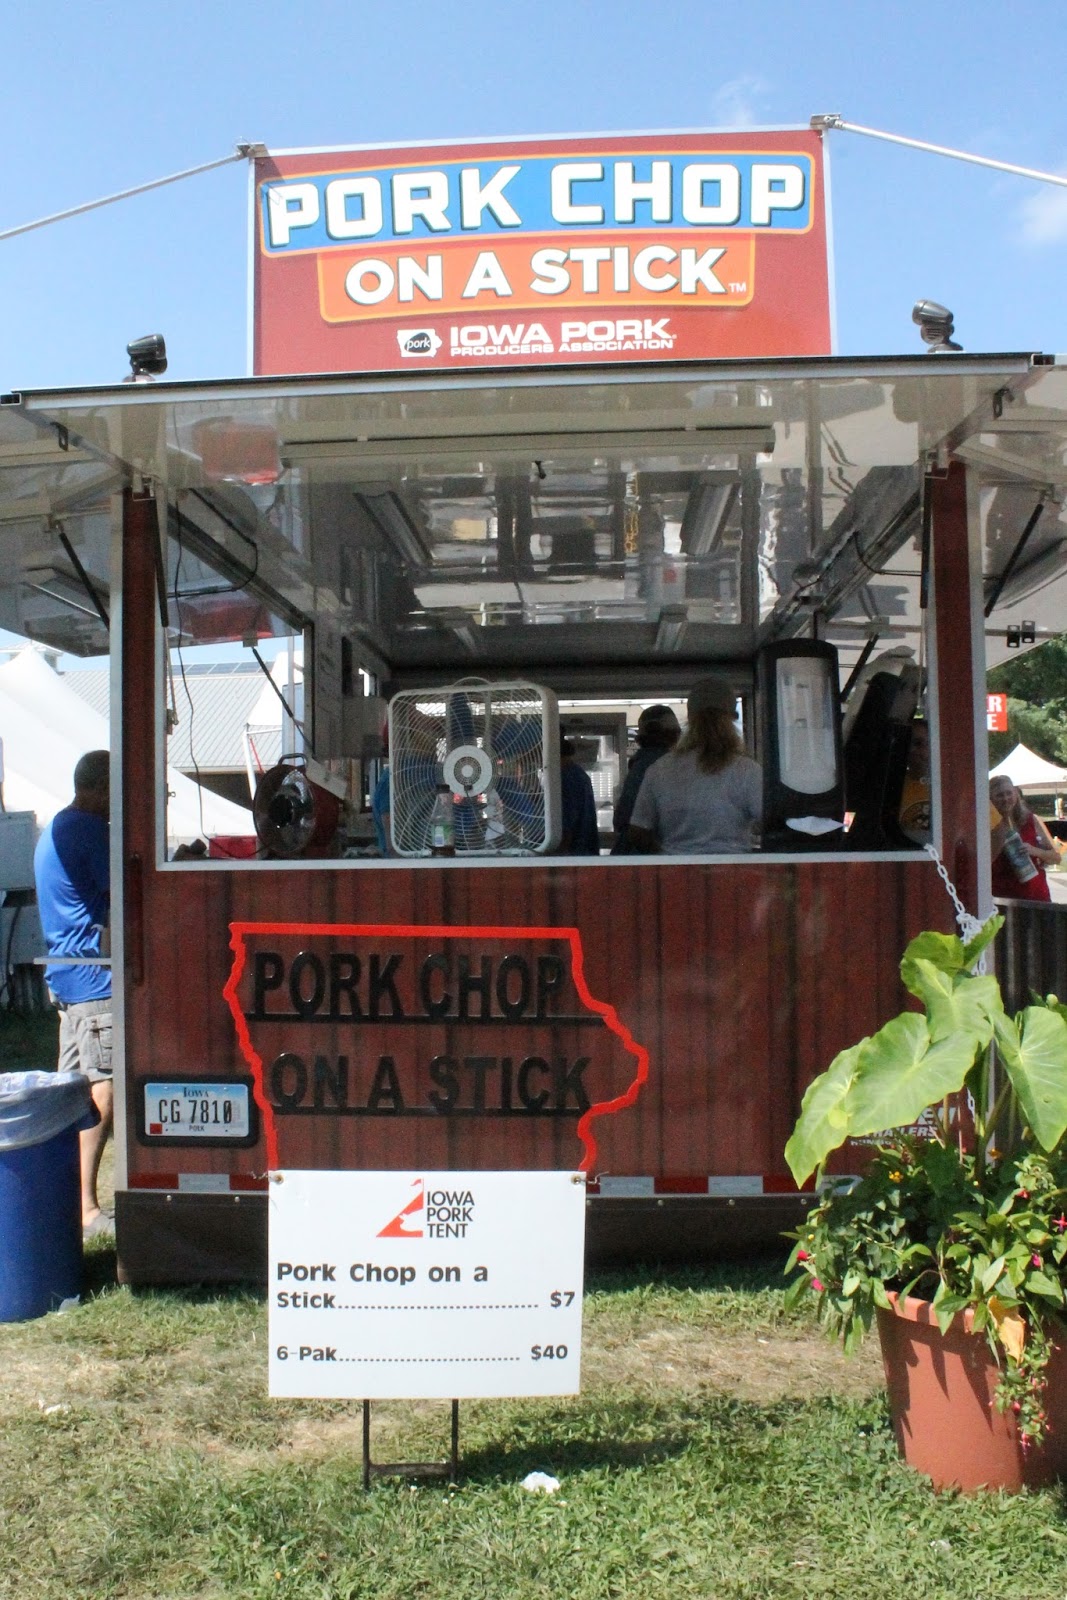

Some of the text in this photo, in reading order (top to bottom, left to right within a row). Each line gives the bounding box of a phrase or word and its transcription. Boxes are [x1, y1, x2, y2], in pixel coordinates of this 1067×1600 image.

[269, 160, 806, 247] PORK CHOP
[345, 254, 443, 306] ON
[462, 251, 513, 299] A
[530, 246, 728, 296] STICK
[450, 323, 552, 346] IOWA
[407, 338, 431, 352] pork
[450, 338, 674, 356] PRODUCERS ASSOCIATION
[255, 952, 565, 1018] PORK CHOP
[271, 1053, 592, 1113] ON A STICK
[159, 1099, 233, 1124] CG 7810
[426, 1190, 475, 1206] IOWA
[426, 1206, 473, 1223] PORK
[427, 1223, 469, 1238] TENT
[277, 1262, 489, 1285] Pork Chop on a
[550, 1290, 576, 1308] $7
[531, 1344, 568, 1360] $40
